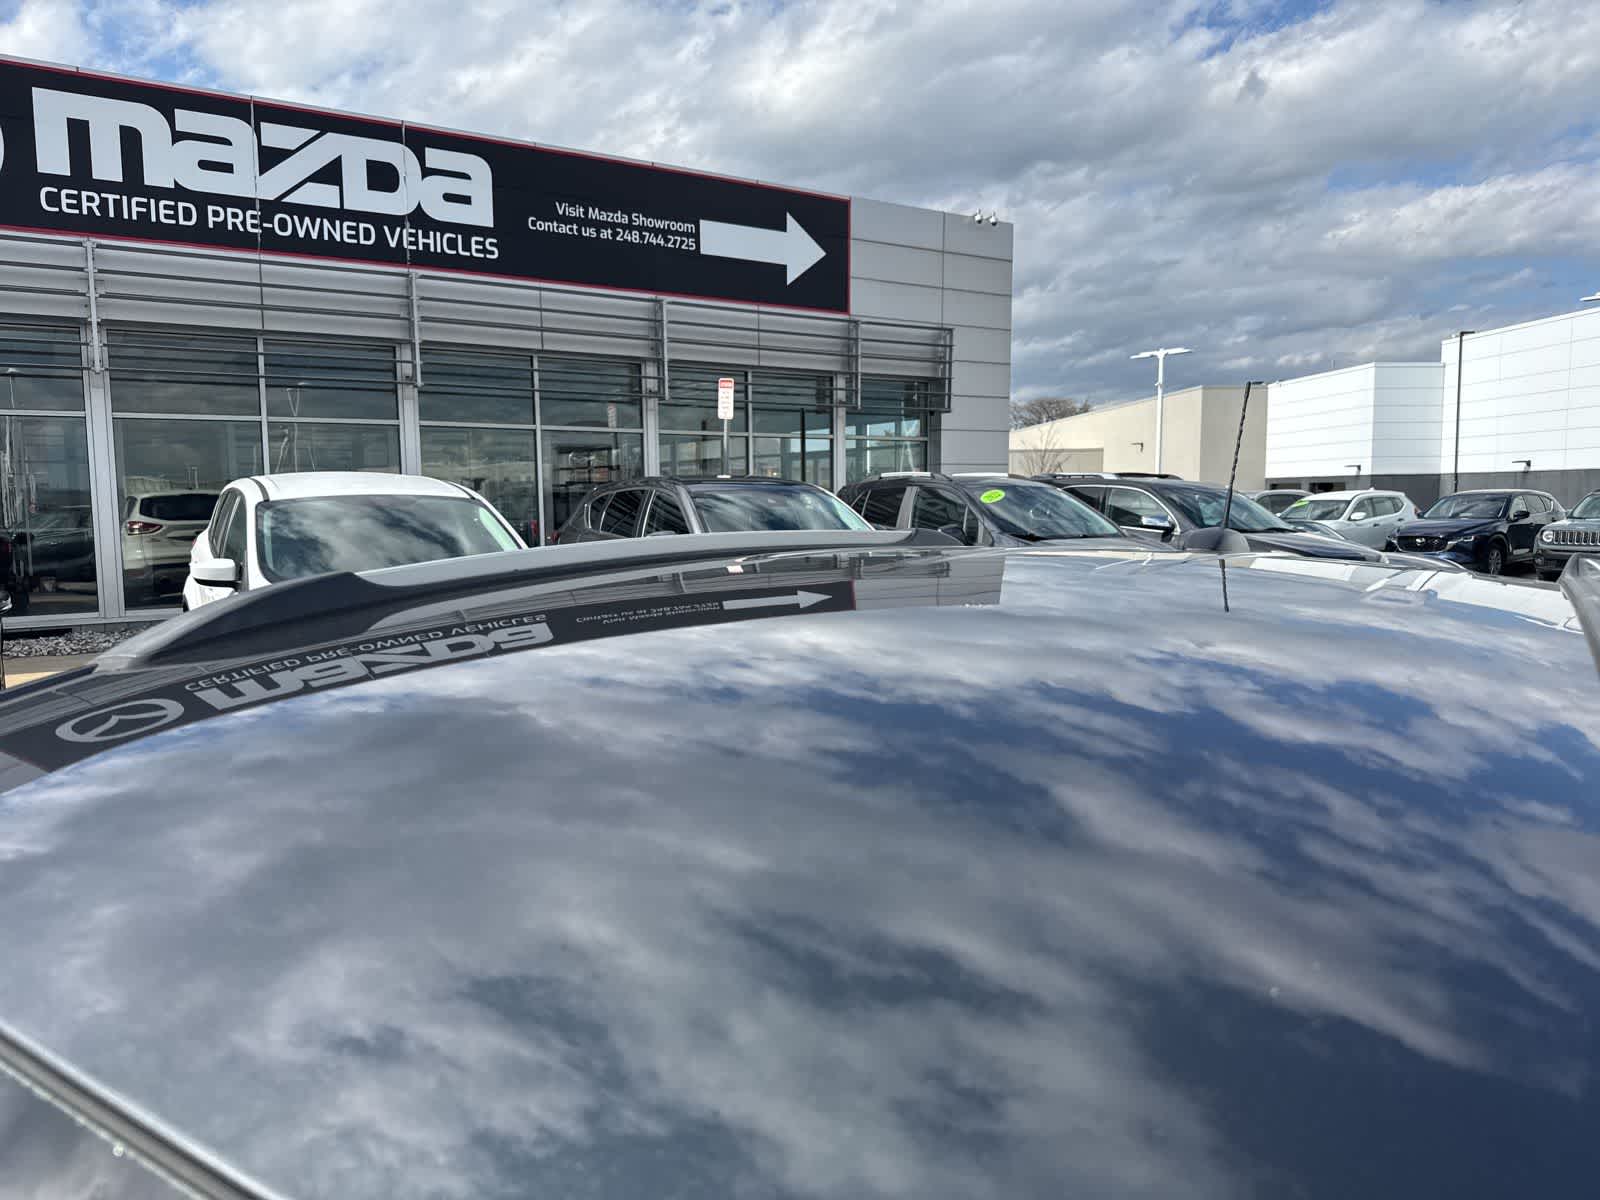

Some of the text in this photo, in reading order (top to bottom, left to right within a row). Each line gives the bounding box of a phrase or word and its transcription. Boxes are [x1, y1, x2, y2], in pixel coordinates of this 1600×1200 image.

[39, 186, 499, 260] CERTIFIED PRE-OWNED VEHICLES
[527, 216, 697, 251] Contact us at 248.744.2725
[555, 201, 696, 234] Visit Mazda Showroom
